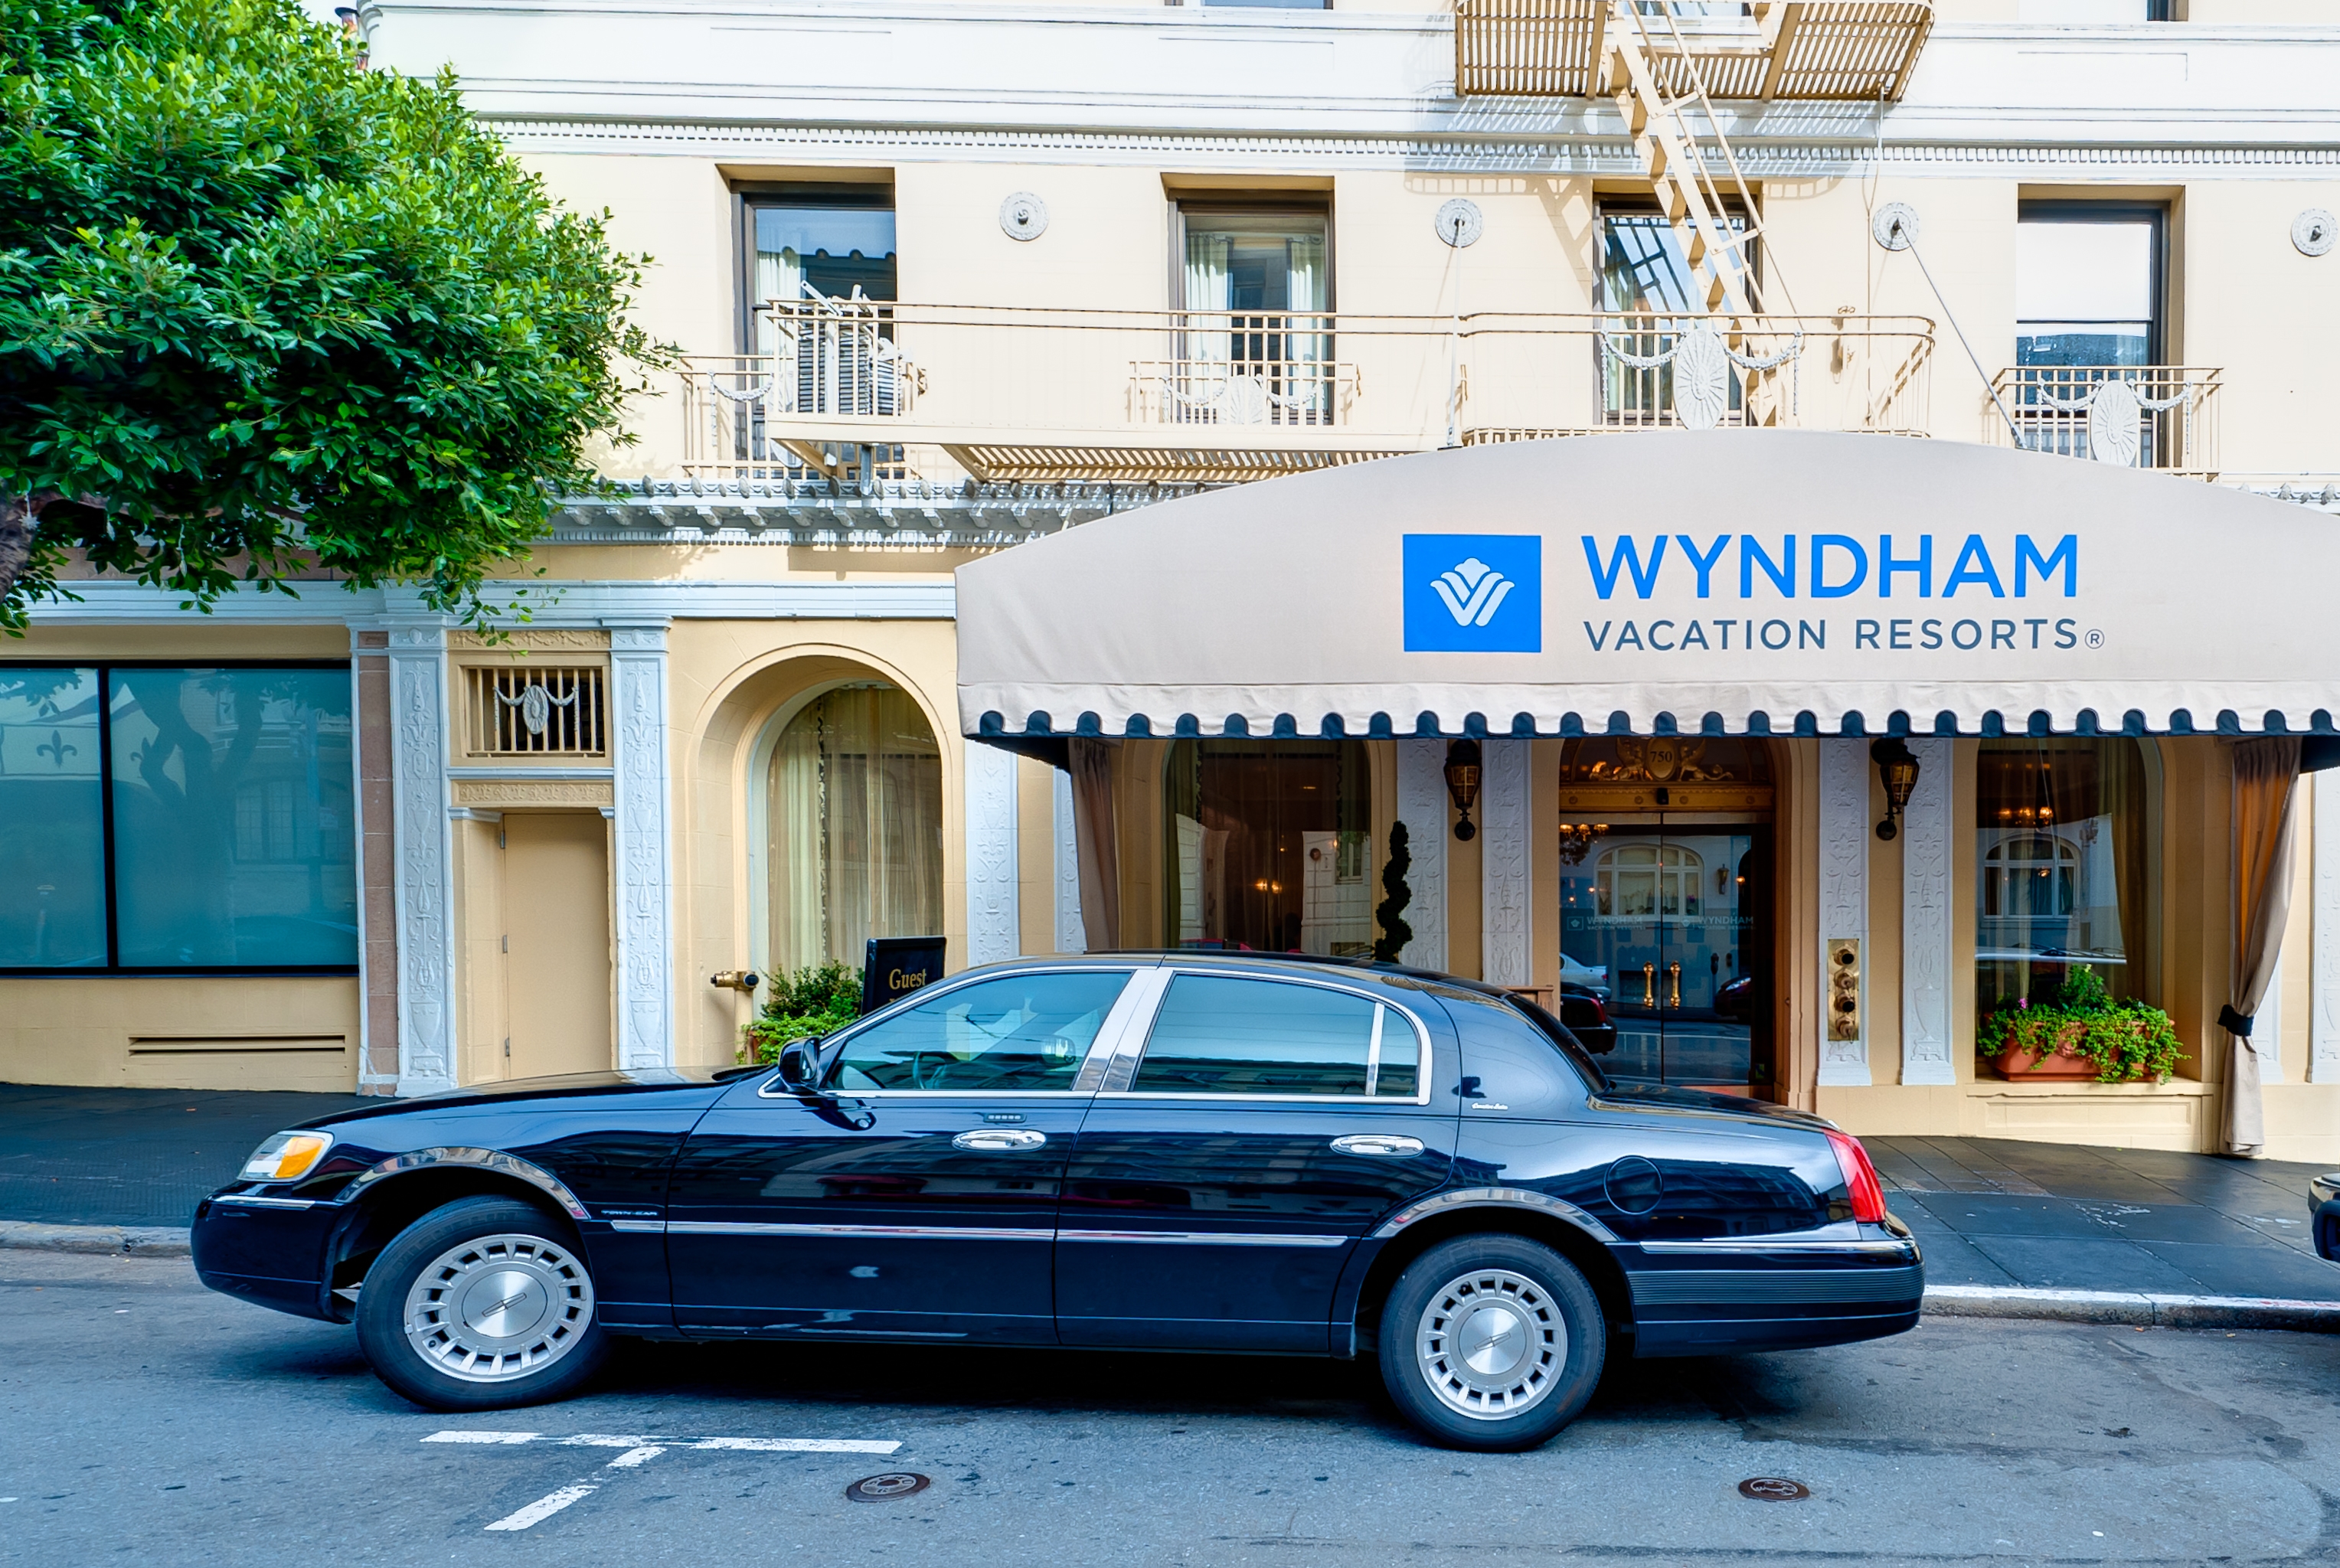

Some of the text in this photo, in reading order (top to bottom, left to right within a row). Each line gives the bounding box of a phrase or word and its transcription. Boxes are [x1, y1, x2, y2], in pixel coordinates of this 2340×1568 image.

[1580, 534, 2078, 600] WYNDHAM
[1583, 619, 1829, 652] VACATION
[1650, 750, 1672, 763] 750
[1698, 916, 1753, 925] WYNDHAM
[889, 968, 927, 990] Guest
